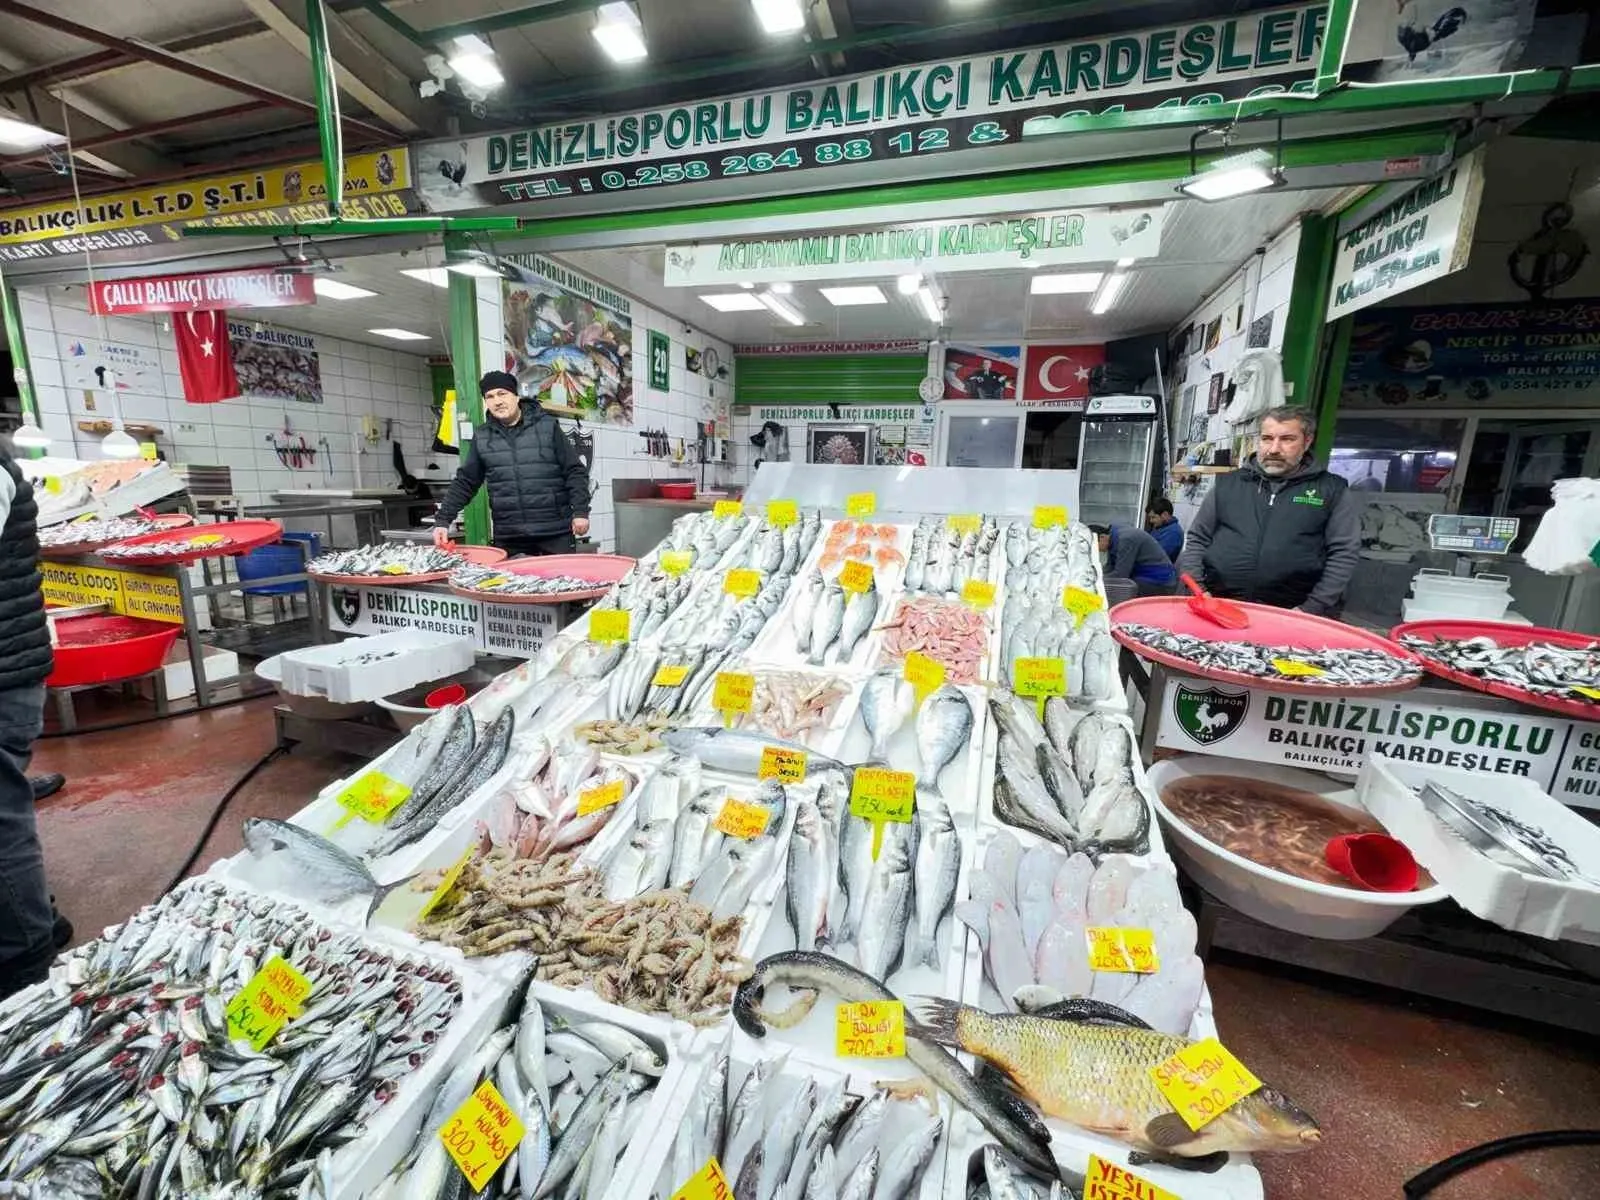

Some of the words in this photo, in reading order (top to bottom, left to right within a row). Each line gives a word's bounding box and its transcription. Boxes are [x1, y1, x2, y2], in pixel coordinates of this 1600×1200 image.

[785, 62, 971, 134] BALIKÇI
[988, 8, 1329, 105] KARDEŞLER
[501, 178, 573, 200] TEL
[602, 160, 711, 189] 0.258
[721, 147, 803, 175] 264
[815, 139, 872, 163] 88
[889, 128, 949, 154] 12
[968, 121, 1009, 144] &
[0, 202, 124, 235] BALIKÇILIK
[845, 227, 934, 265] BALIKÇI
[938, 213, 1085, 259] KARDEŞLER
[1353, 214, 1429, 272] BALIKÇI
[103, 284, 142, 311] ÇALLI
[146, 279, 200, 307] BALIKÇI
[864, 408, 915, 422] KARDEŞLER
[367, 591, 479, 622] DENİZLİSPORLU
[488, 622, 514, 634] KEMAL
[1264, 697, 1554, 755] DENİZLİSPORLU
[1268, 728, 1365, 757] BALIKÇI
[1374, 741, 1532, 778] KARDEŞLER
[1285, 751, 1358, 768] BALIKÇILIK
[1571, 755, 1600, 773] KE
[1564, 777, 1600, 796] MU
